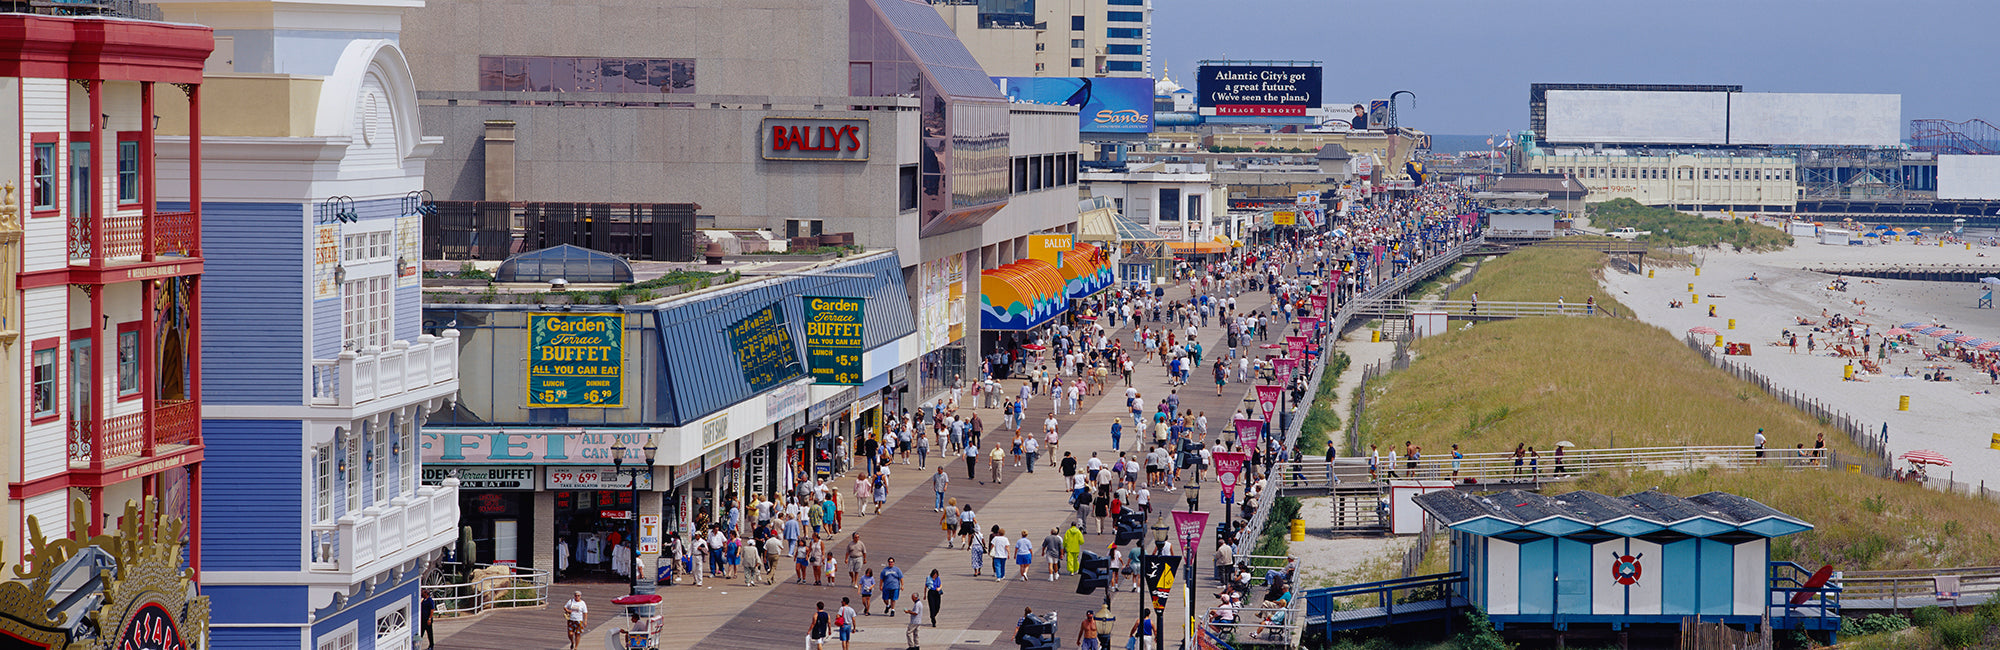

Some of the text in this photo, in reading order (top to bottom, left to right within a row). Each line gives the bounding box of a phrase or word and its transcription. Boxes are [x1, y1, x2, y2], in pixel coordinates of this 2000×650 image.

[1215, 70, 1306, 83] Atlantic City's got
[1233, 83, 1259, 94] great
[1262, 81, 1297, 91] future.
[1211, 91, 1240, 102] (We've
[1263, 92, 1279, 101] the
[1280, 91, 1310, 104] plans.)
[1094, 109, 1149, 123] Sands
[772, 125, 861, 152] BALLY'S
[319, 228, 334, 245] REAL
[1044, 238, 1071, 249] BALLY'S
[315, 245, 338, 265] ESTATE
[811, 298, 858, 311] Garden
[813, 312, 855, 322] Terrace
[546, 317, 606, 332] Garden
[807, 322, 862, 337] BUFFET
[550, 333, 603, 345] Terrace
[541, 345, 612, 361] BUFFET
[835, 354, 859, 366] $5.99
[532, 365, 620, 375] ALL YOU CAN EAT
[835, 372, 859, 384] $6.99
[539, 389, 612, 403] $5.99 $6.99
[703, 421, 716, 446] GIFT
[715, 416, 729, 441] SHOP
[581, 433, 607, 445] ALL
[612, 433, 640, 445] YOU
[581, 447, 609, 460] CAN
[1218, 459, 1240, 467] BALLY'S
[457, 468, 488, 480] Terrace
[488, 468, 533, 480] BUFFET
[680, 495, 688, 523] TAROT
[644, 525, 655, 536] T
